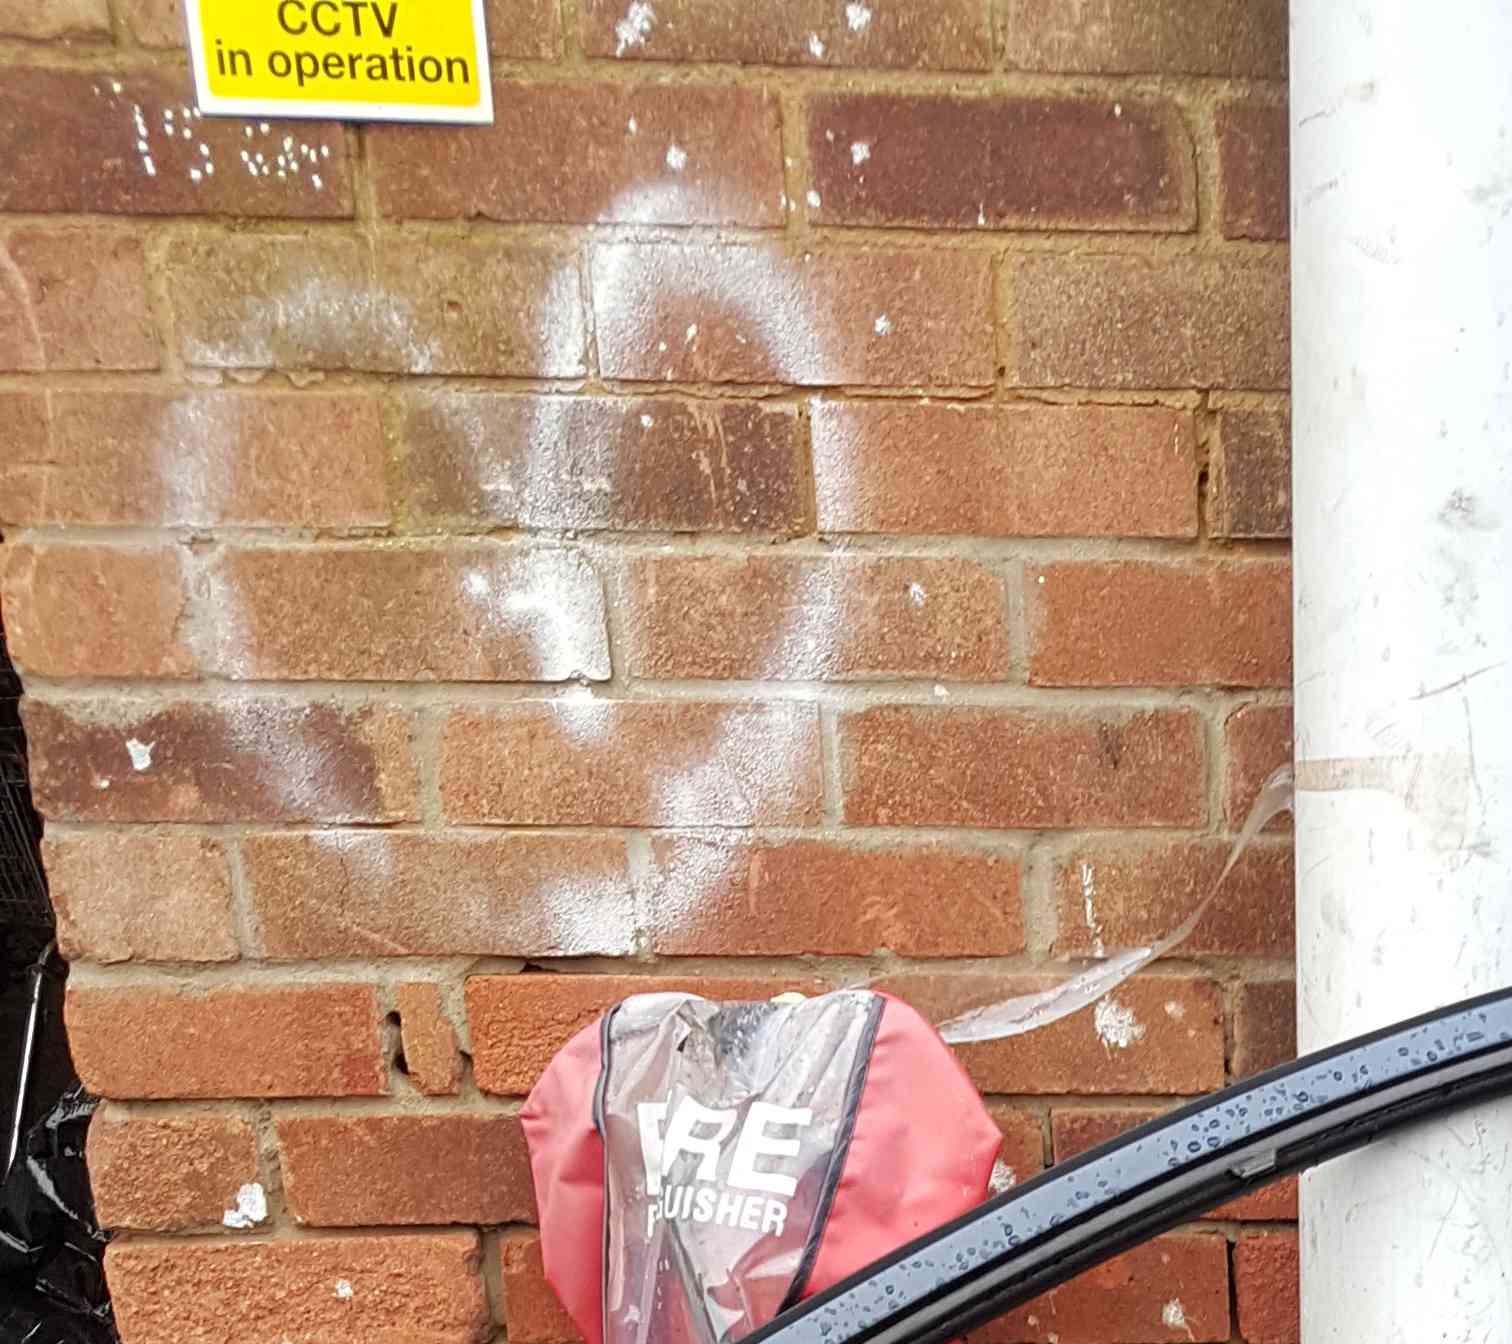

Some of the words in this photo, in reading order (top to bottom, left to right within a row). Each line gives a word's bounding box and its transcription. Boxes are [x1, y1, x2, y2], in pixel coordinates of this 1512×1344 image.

[277, 0, 399, 38] CCTV
[215, 39, 253, 77] in
[268, 46, 471, 87] operation
